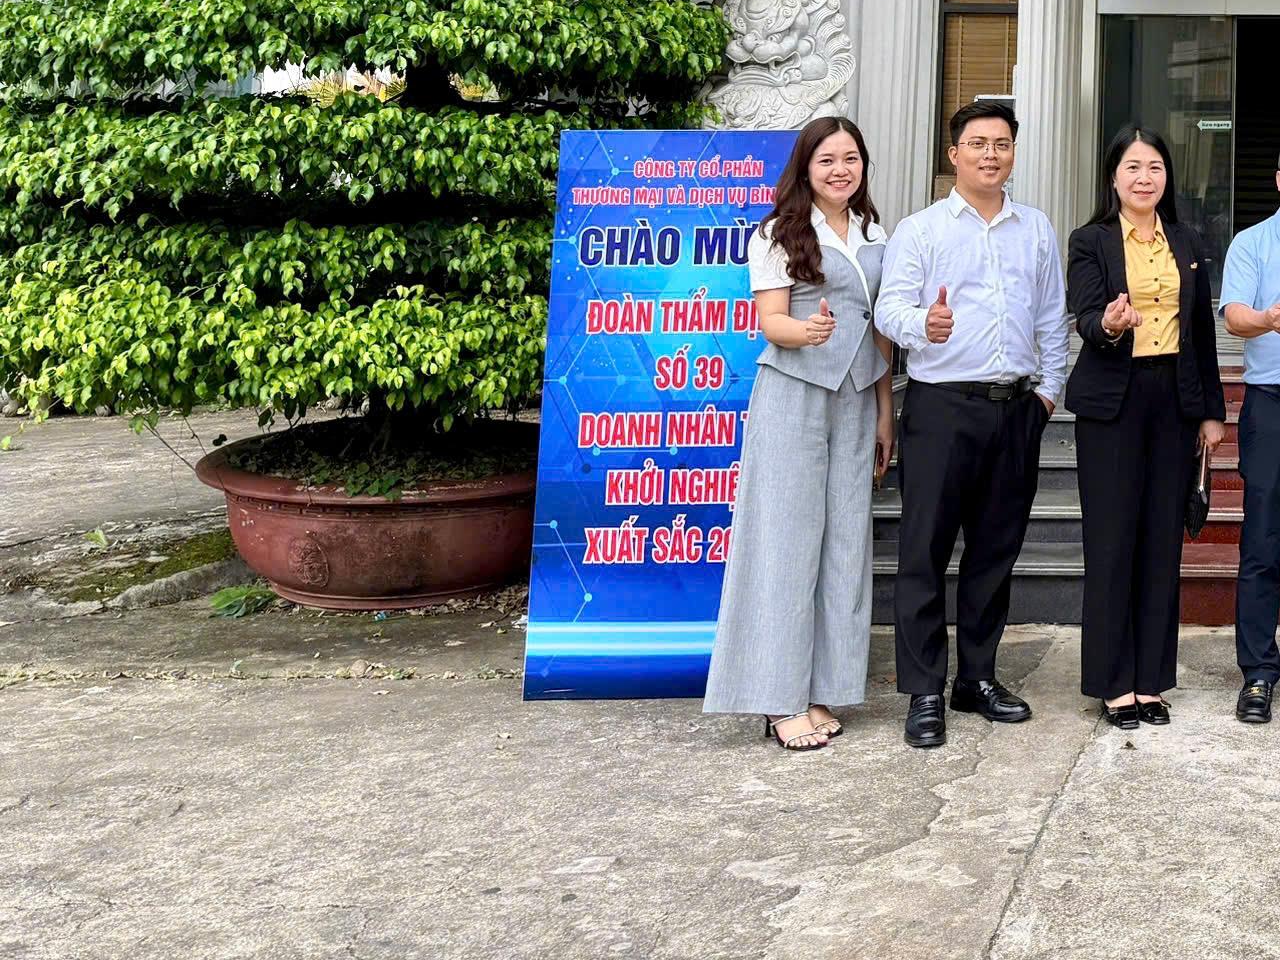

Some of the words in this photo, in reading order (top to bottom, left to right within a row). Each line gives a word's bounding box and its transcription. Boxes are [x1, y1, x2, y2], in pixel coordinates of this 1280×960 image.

[634, 159, 674, 178] CÔNG
[679, 161, 696, 177] TY
[699, 155, 720, 177] CỔ
[722, 156, 763, 177] PHẦN
[572, 187, 630, 205] THƯƠNG
[634, 188, 662, 208] MẠI
[667, 183, 686, 204] VÀ
[689, 187, 724, 208] DỊCH
[727, 188, 748, 208] VỤ
[750, 186, 776, 205] BÌN
[580, 218, 681, 267] CHÀO
[587, 293, 652, 334] ĐOÀN
[661, 287, 726, 333] THẨM
[655, 344, 691, 390] SỐ
[695, 355, 724, 390] 39
[579, 413, 662, 448] DOANH
[667, 406, 736, 447] NHÂN
[606, 459, 664, 505] KHỞI
[668, 462, 741, 510] NGHIỆ
[583, 515, 649, 563] XUẤT
[653, 515, 702, 562] SẮC
